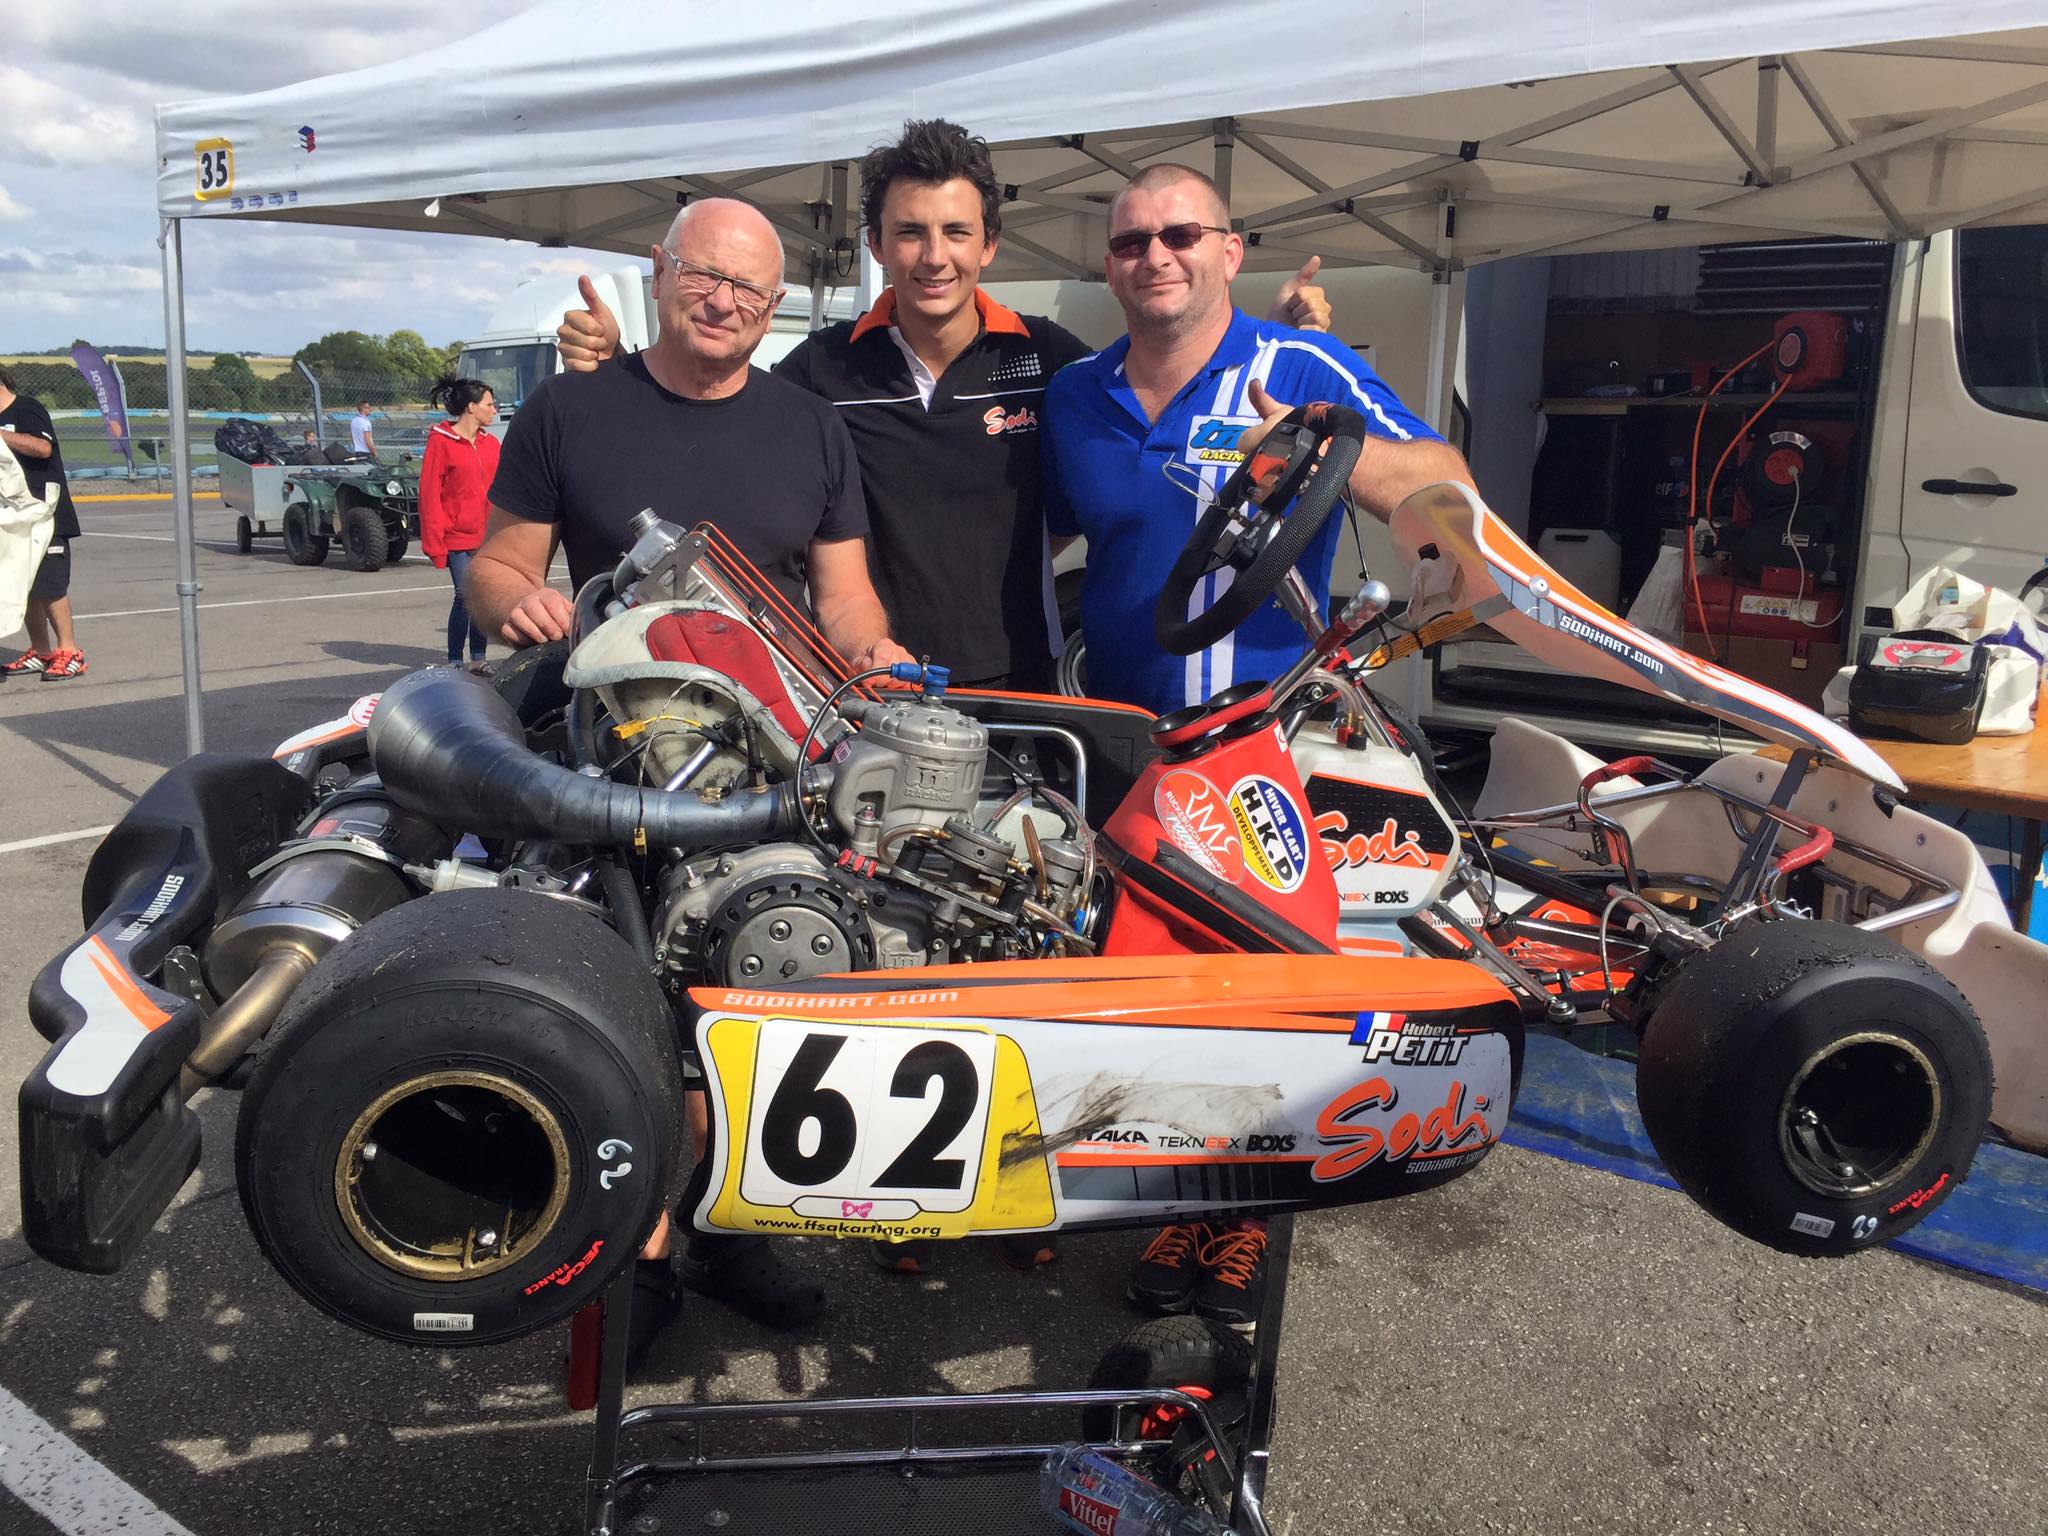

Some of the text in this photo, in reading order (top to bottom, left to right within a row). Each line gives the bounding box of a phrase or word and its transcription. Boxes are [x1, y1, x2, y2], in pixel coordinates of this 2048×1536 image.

[200, 150, 228, 190] 35
[983, 406, 1038, 435] Sodi
[1199, 450, 1246, 462] RACIN
[1165, 791, 1227, 874] RUCKEBUSCH MATHIEU
[1233, 806, 1275, 881] DEVELOPPEMENT
[1264, 787, 1304, 863] HIVER KART
[1402, 1022, 1456, 1036] Hubert
[761, 1033, 979, 1190] 62
[1311, 1076, 1493, 1184] Sodi
[1157, 1135, 1241, 1149] TEKNEEX
[597, 1138, 633, 1190] 62
[1887, 1188, 1924, 1215] FRANCE
[1910, 1172, 1950, 1209] VEGA
[754, 1219, 942, 1237] www.ffsakarting.org
[523, 1263, 571, 1296] FRANCE
[556, 1240, 605, 1286] VEGA
[1069, 1491, 1114, 1536] Vittel
